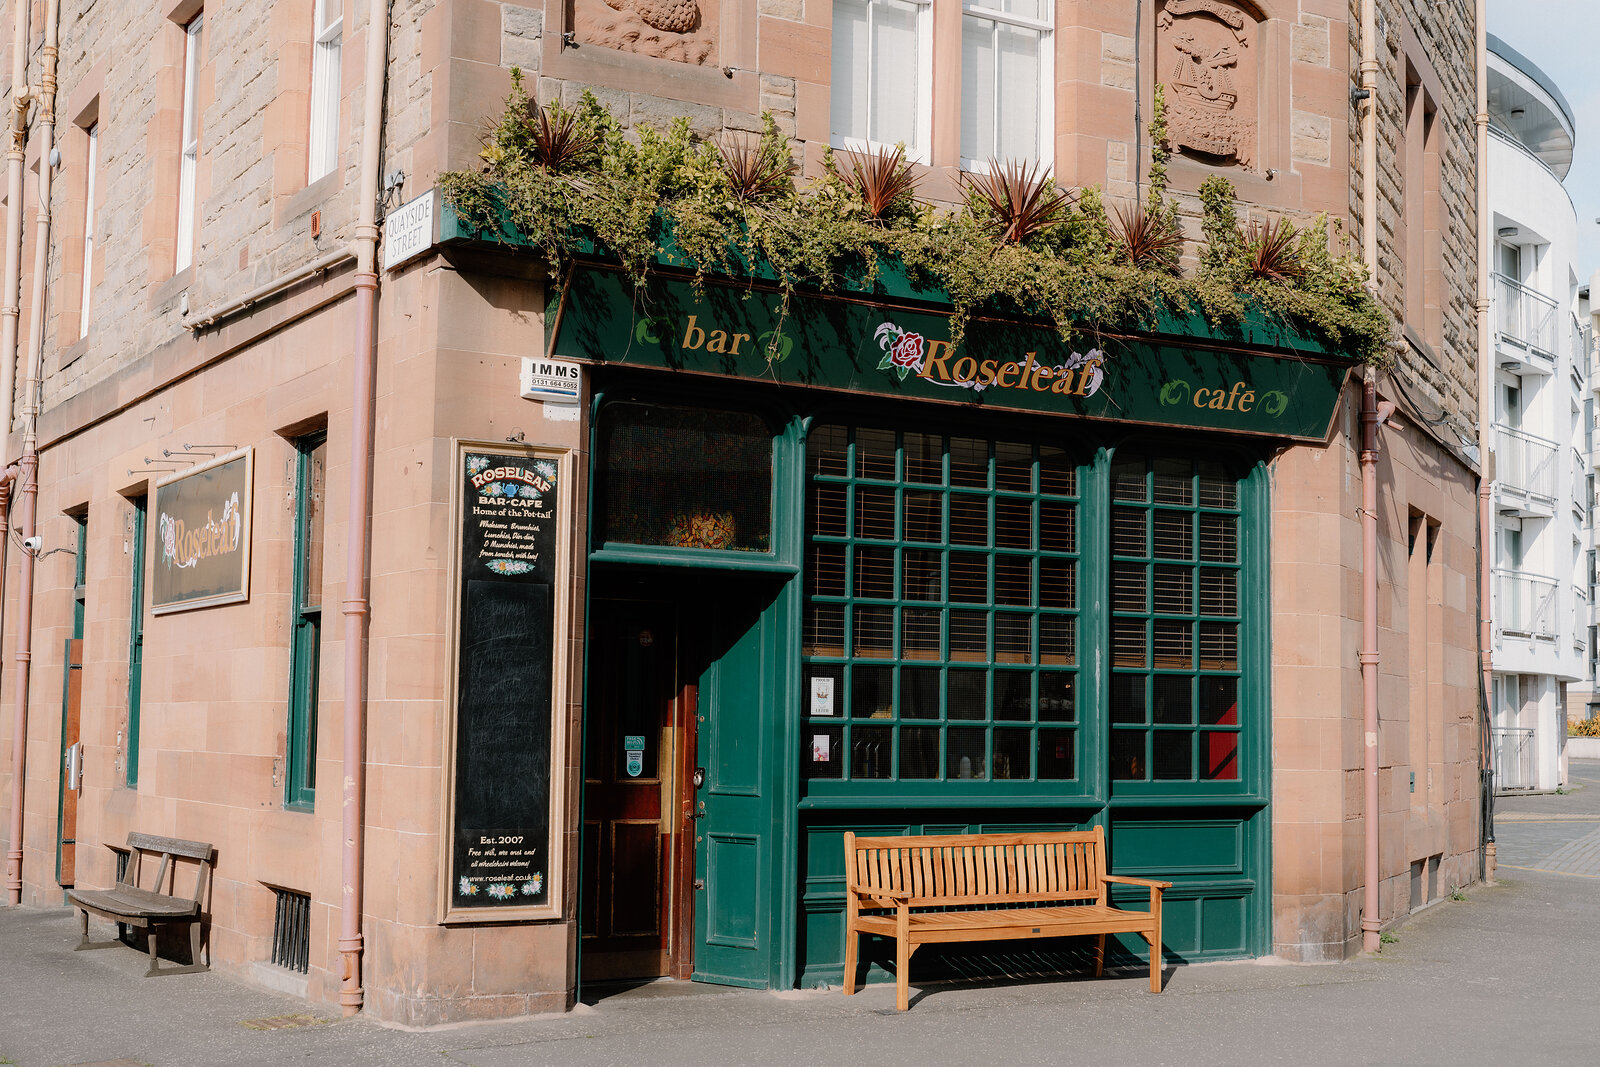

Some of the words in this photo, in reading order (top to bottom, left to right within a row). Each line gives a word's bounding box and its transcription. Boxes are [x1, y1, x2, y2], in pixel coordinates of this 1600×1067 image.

[388, 199, 430, 238] QUAYSIDE
[392, 225, 423, 258] STREET
[682, 315, 751, 355] bar
[532, 363, 579, 379] IMMS
[916, 339, 1102, 397] Roseleaf
[470, 466, 551, 493] ROSELEAF
[478, 496, 543, 508] BAR-CAFE
[472, 506, 497, 516] Home
[498, 508, 507, 517] of
[507, 508, 522, 517] the
[173, 502, 239, 565] Roseleaf
[519, 542, 535, 550] made
[478, 549, 494, 558] from
[480, 836, 498, 845] Est.
[498, 836, 524, 844] 2007
[468, 847, 482, 856] Free
[523, 848, 537, 856] and
[469, 873, 532, 882] www.roseleaf.co.uk
